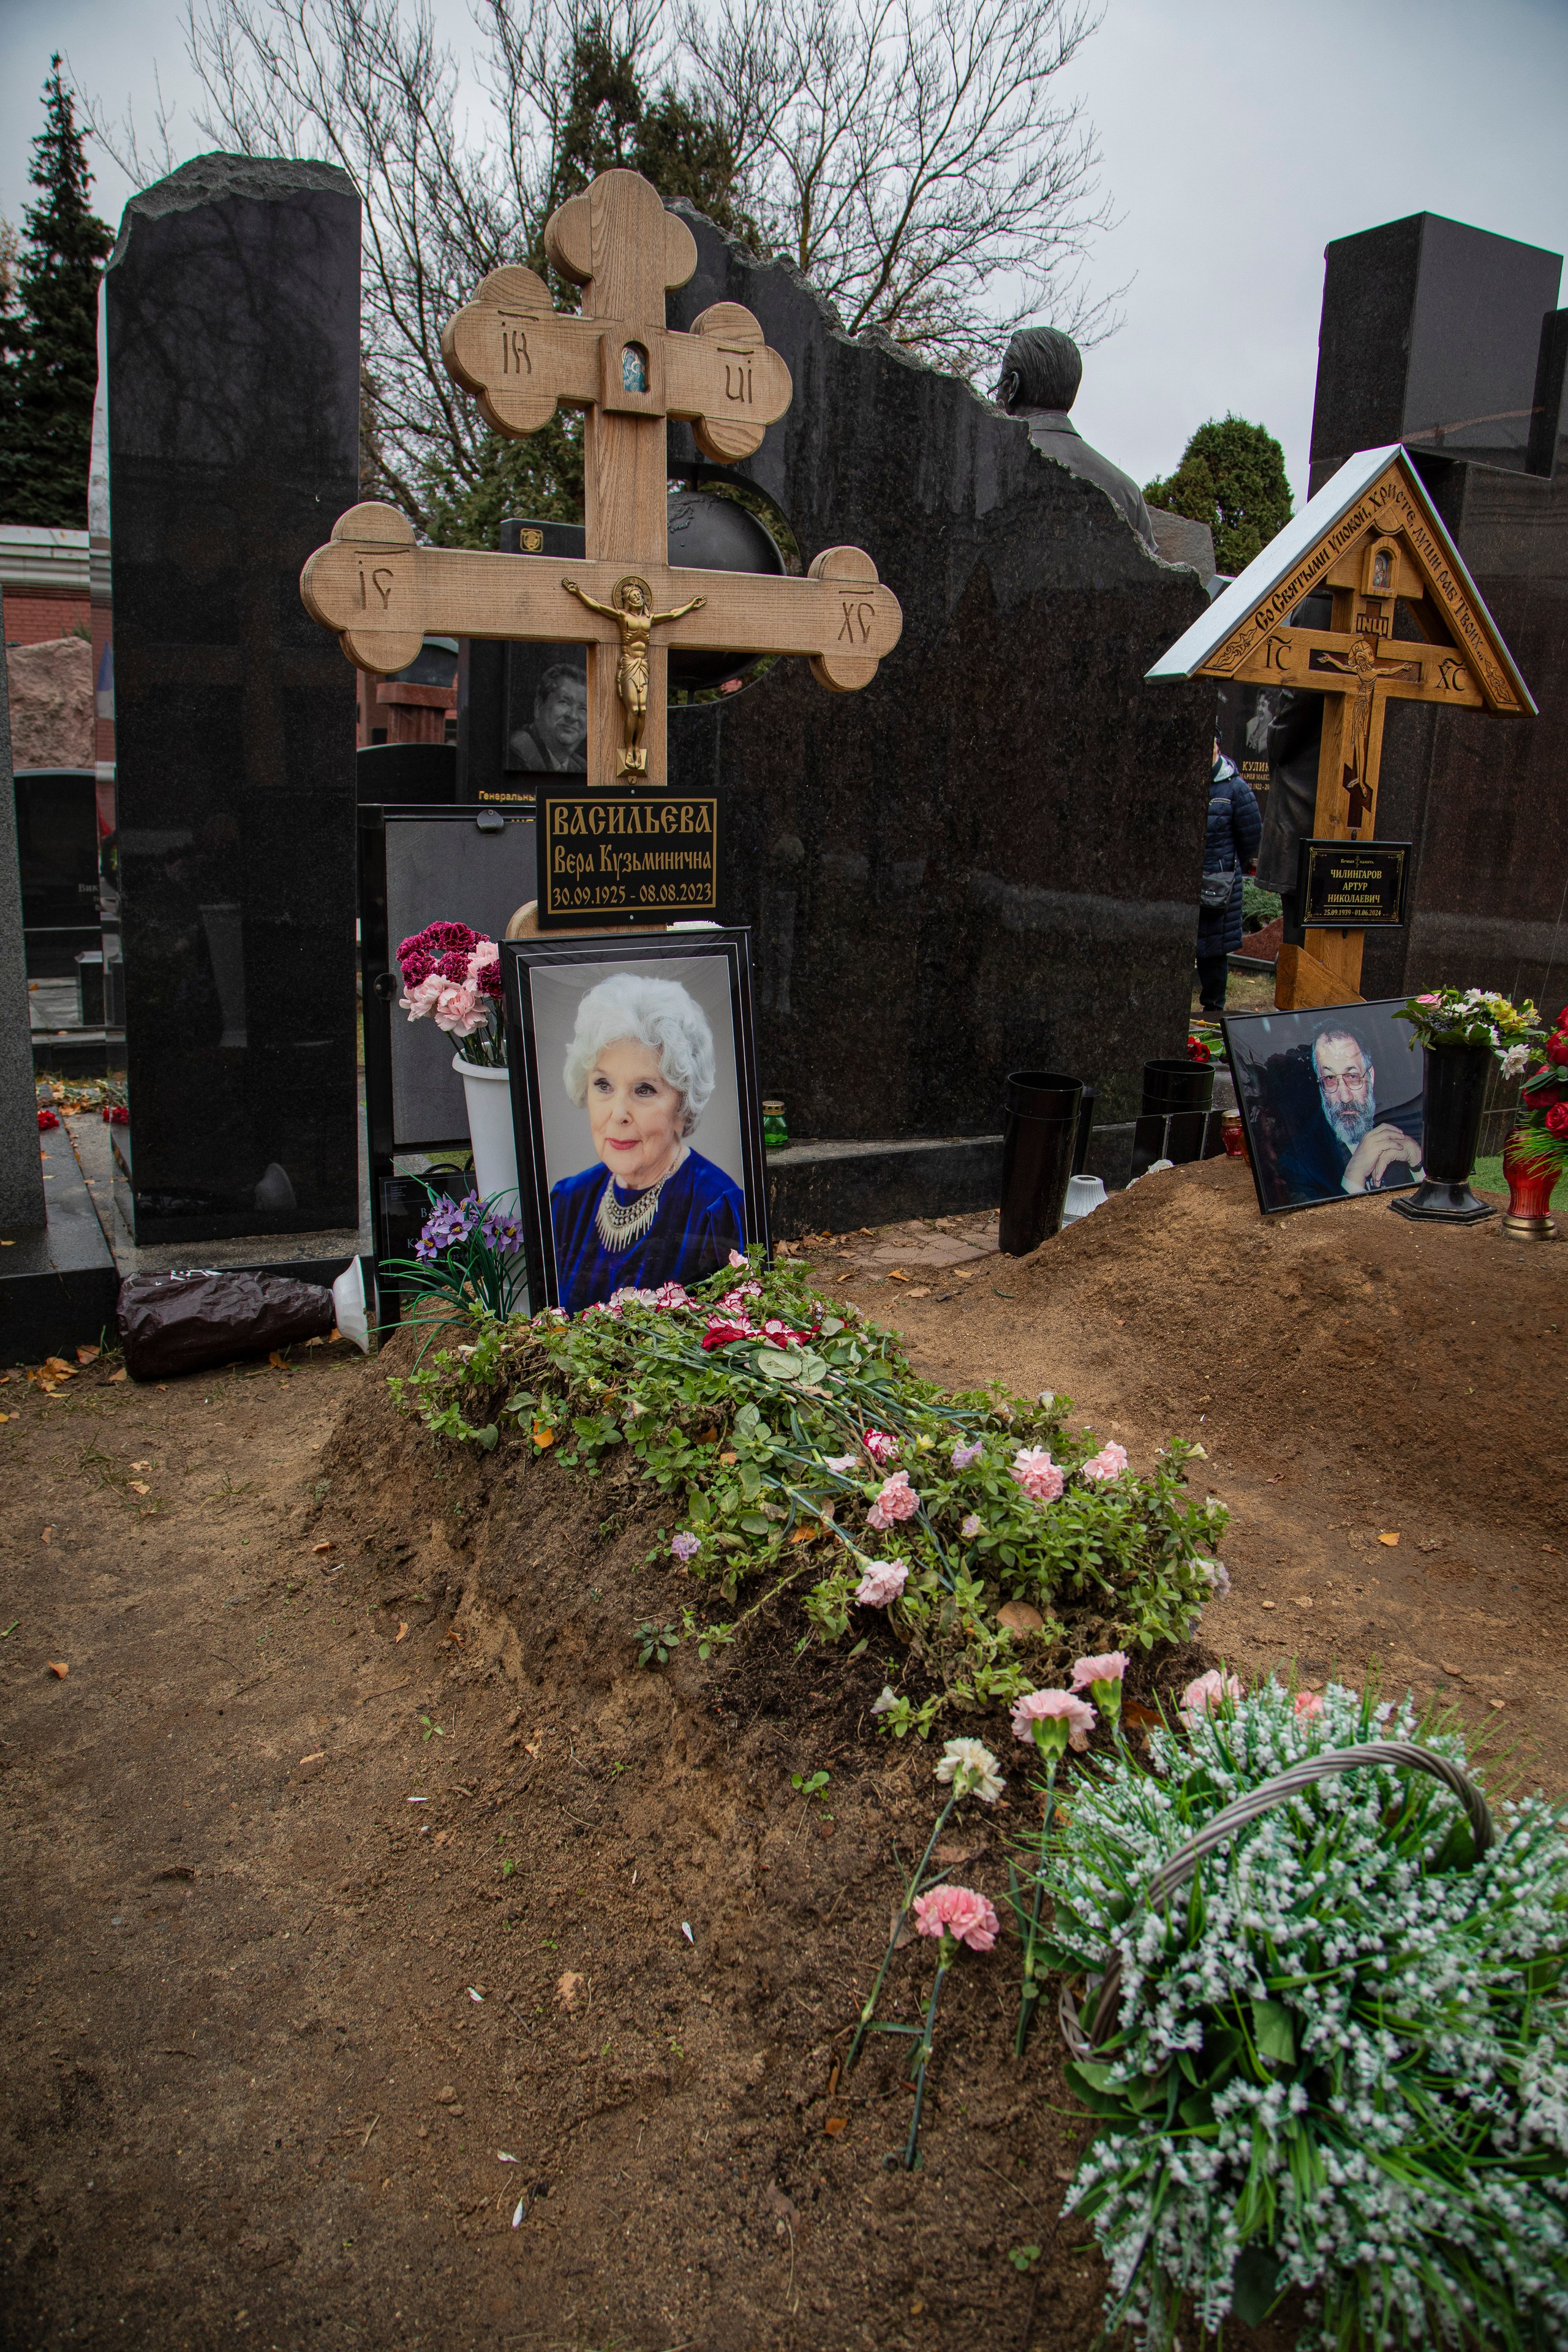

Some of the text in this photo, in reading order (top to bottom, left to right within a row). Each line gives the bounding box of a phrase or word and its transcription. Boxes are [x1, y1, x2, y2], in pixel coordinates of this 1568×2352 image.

[478, 791, 536, 802] Генеральны
[552, 805, 712, 835] ВАСИЛЬЕВА
[554, 844, 712, 881] Вера Кузьминична
[1330, 869, 1382, 879] ЧИЛИНГАРОВ
[1343, 882, 1368, 891] АРТУР
[552, 885, 626, 907] 30.09.1925
[639, 883, 712, 903] 08.08.2023
[1327, 894, 1380, 903] НИКОЛАЕВИЧ
